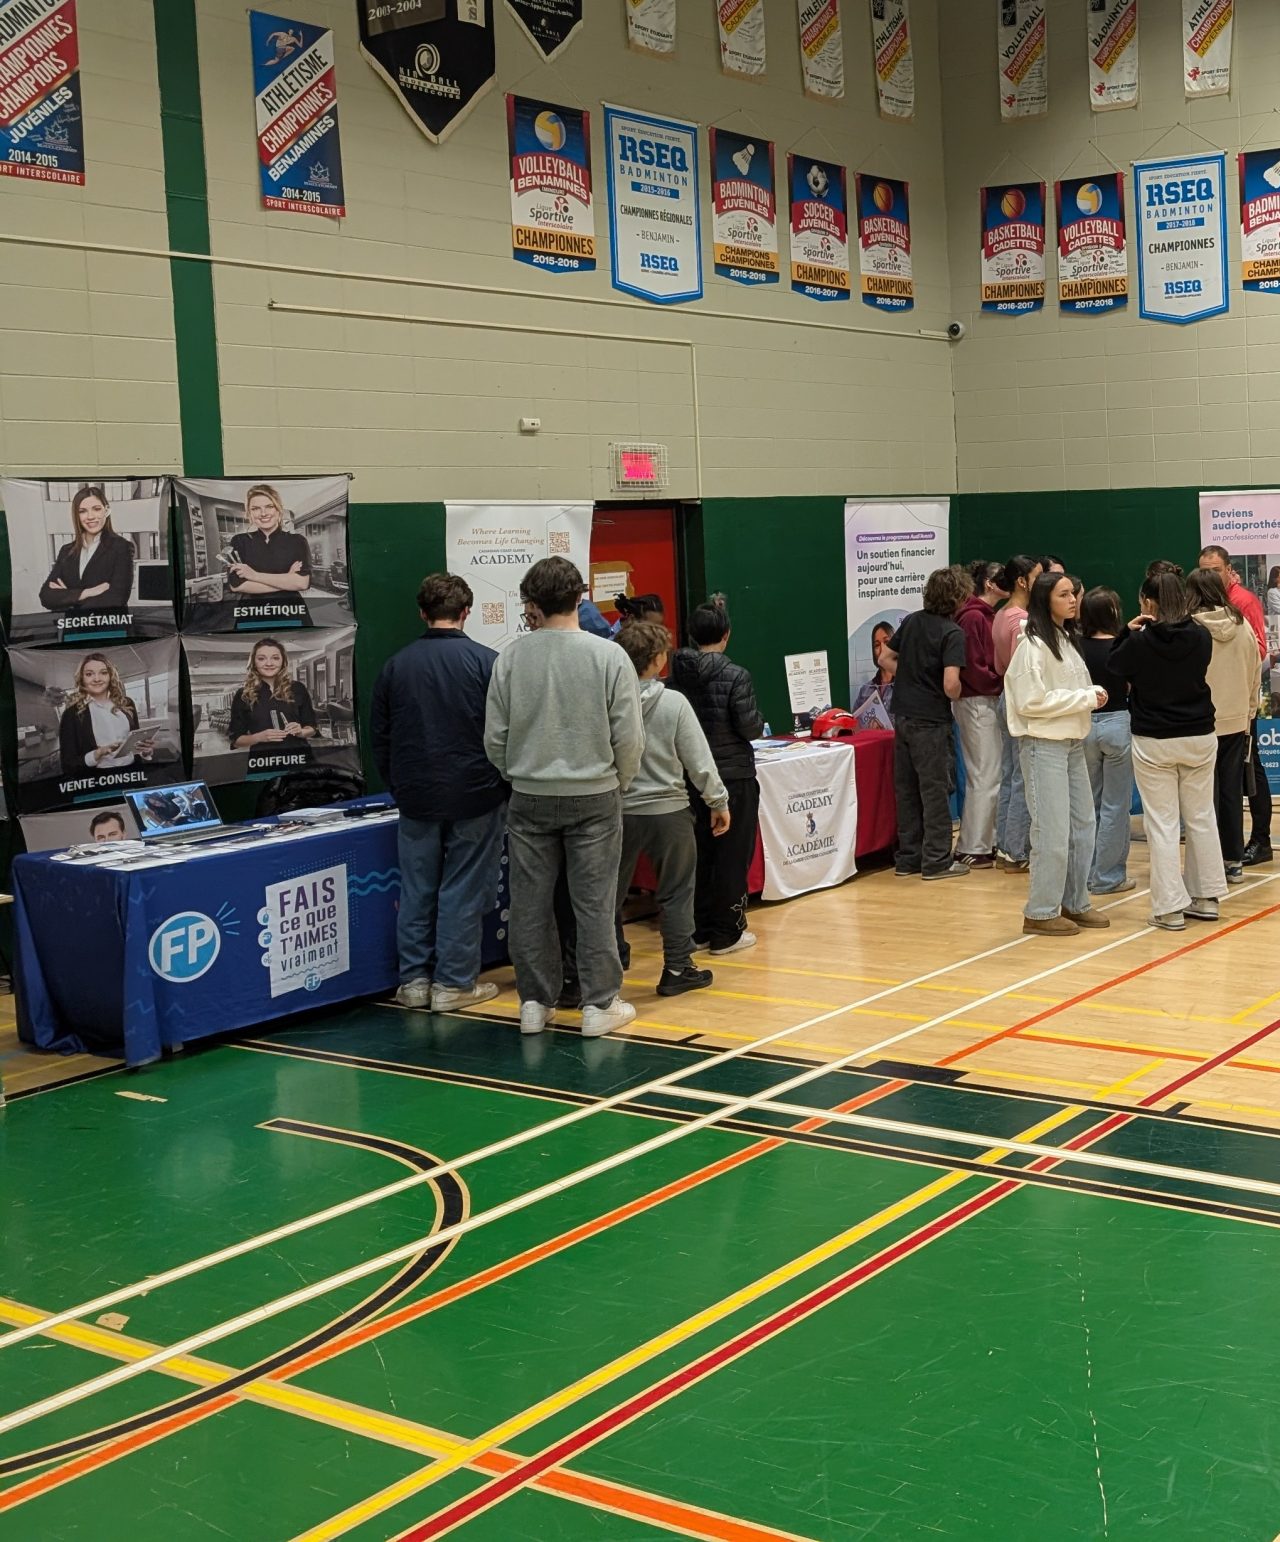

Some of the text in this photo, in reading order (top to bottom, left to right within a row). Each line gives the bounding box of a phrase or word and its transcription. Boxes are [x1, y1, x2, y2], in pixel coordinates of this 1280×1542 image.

[368, 1, 422, 21] 2003-2004
[1002, 6, 1044, 59] VOLLEYBALL
[261, 48, 328, 116] ATHLÉTISME
[9, 86, 73, 144] JUVÉNILES
[262, 81, 333, 153] CHAMPIONNES
[268, 115, 335, 182] BENJAMINES
[619, 135, 689, 172] RSEQ
[8, 149, 58, 167] 2014-2015
[16, 166, 80, 184] INTERSCOLAIRE
[519, 156, 585, 187] VOLLEYBALL
[620, 164, 688, 186] BADMINTON
[282, 187, 320, 202] 2014-2015
[518, 175, 588, 200] BENJAMINES
[720, 182, 770, 207] BADMINTON
[1146, 178, 1214, 206] RSEQ
[266, 199, 341, 216] SPORT INTERSCOLAIRE
[530, 208, 574, 224] Sportive
[621, 204, 693, 226] CHAMPIONNES RÉGIONALES
[804, 203, 834, 223] SOCCER
[1146, 203, 1213, 219] BADMINTON
[642, 230, 675, 244] BENJAMIN
[728, 227, 762, 242] Sportive
[864, 218, 908, 240] BASKETBALL
[988, 223, 1041, 246] BASKETBALL
[1064, 219, 1119, 242] VOLLEYBALL
[516, 228, 593, 256] CHAMPIONNES
[993, 239, 1037, 253] CADETTES
[1068, 234, 1115, 251] CADETTES
[1148, 237, 1215, 254] CHAMPIONNES
[533, 254, 579, 268] 2015-2016
[720, 254, 775, 269] CHAMPIONNES
[725, 246, 770, 260] CHAMPIONS
[803, 247, 834, 261] Sportive
[640, 252, 679, 272] RSEQ
[873, 260, 901, 270] Sportive
[1072, 262, 1108, 275] Sportive
[1166, 261, 1199, 271] BENJAMIN
[730, 269, 766, 281] 2015-2016
[797, 265, 846, 286] CHAMPIONS
[996, 265, 1031, 277] Sportive
[867, 277, 912, 295] CHAMPIONS
[985, 282, 1044, 299] CHAMPIONNES
[1062, 279, 1126, 298] CHAMPIONNES
[1164, 279, 1202, 295] RSEQ
[1075, 299, 1113, 309] 2017-2018
[1212, 509, 1253, 518] Deviens
[499, 528, 531, 536] Learning
[1222, 532, 1268, 542] professionnel
[1270, 532, 1279, 540] de
[511, 537, 544, 546] Changing
[470, 554, 534, 565] ACADEMY
[857, 547, 935, 559] Un soutien financier
[857, 561, 904, 574] aujourd'hui,
[858, 577, 877, 588] pour
[895, 573, 925, 582] carrière
[858, 584, 926, 600] inspirante demai
[233, 603, 306, 617] ESTHÉTIQUE
[57, 613, 134, 630] SECRÉTARIAT
[249, 754, 306, 769] COIFFURE
[59, 771, 147, 793] VENTE-CONSEIL
[786, 794, 834, 814] ACADEMY
[787, 836, 834, 857] ACADÉMIE
[280, 877, 335, 918] FAIS
[280, 904, 336, 934] ce que
[161, 920, 214, 973] FP
[280, 922, 337, 955] T'AIMES
[281, 939, 338, 972] vraiment
